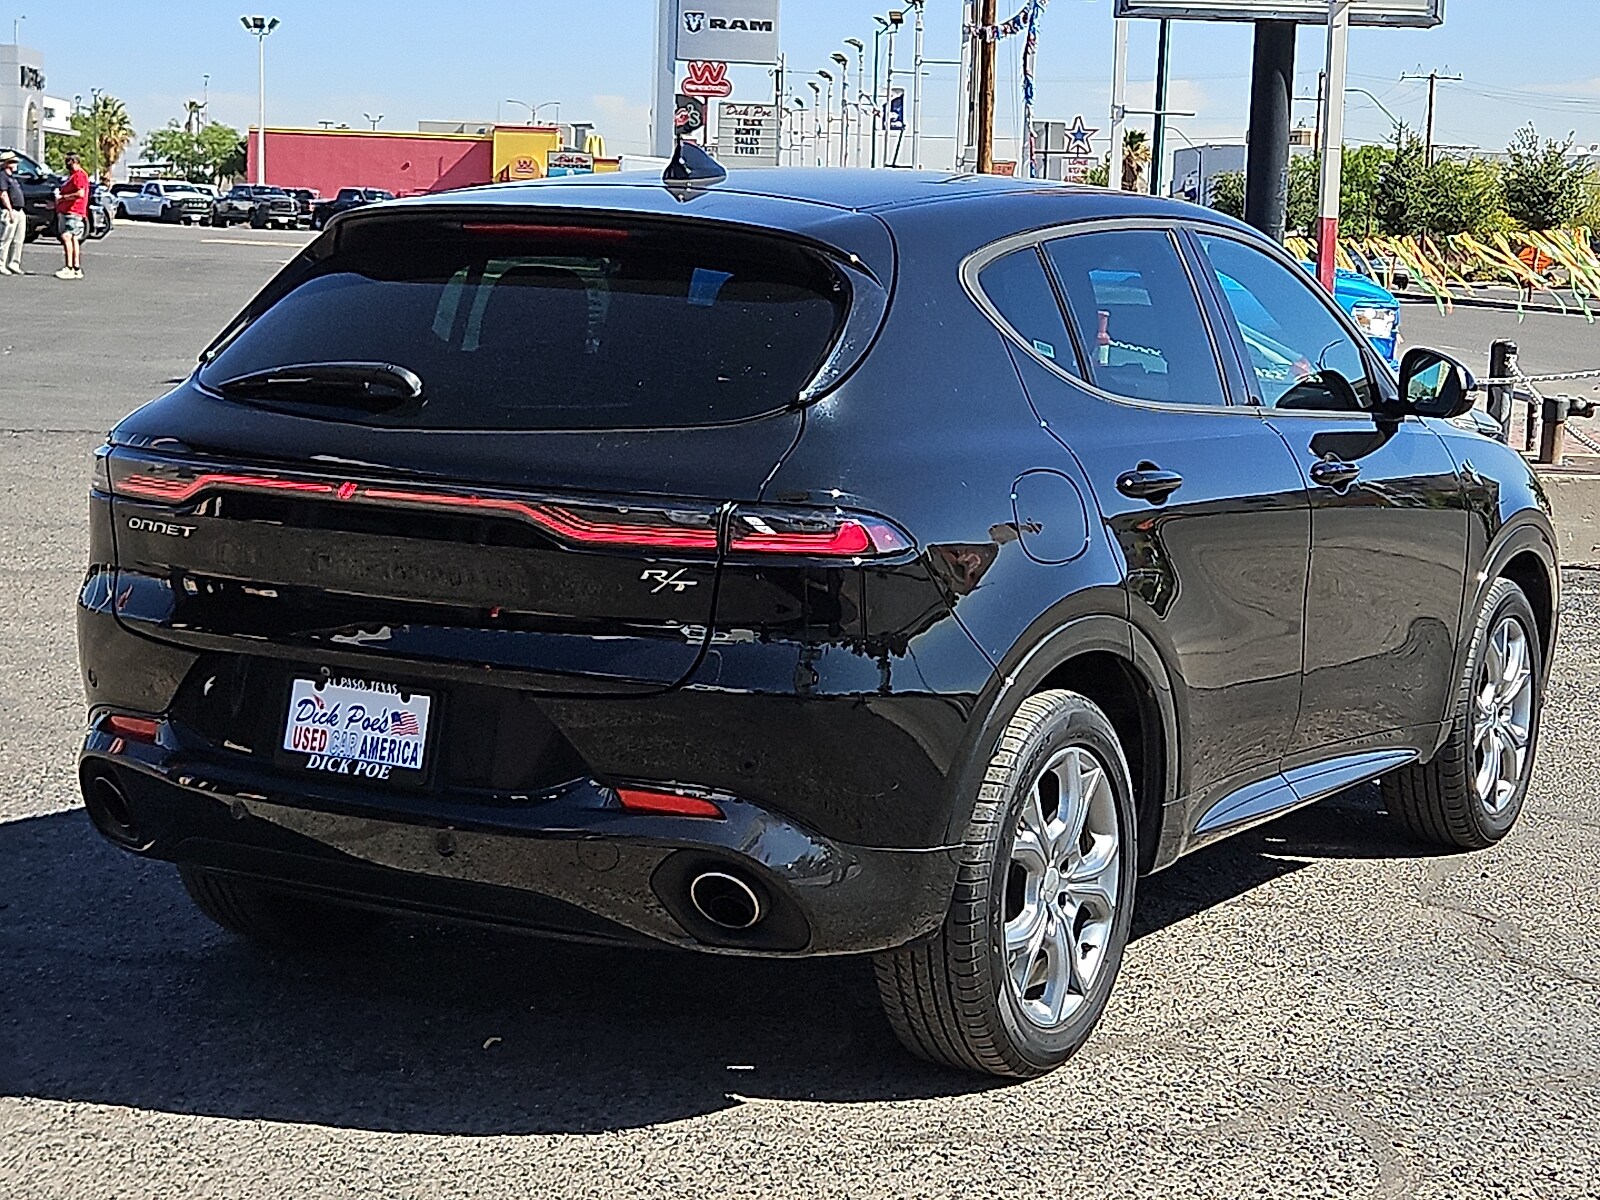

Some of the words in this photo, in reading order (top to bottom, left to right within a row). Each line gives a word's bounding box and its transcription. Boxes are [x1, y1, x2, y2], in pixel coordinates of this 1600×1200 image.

[709, 18, 773, 32] RAM
[753, 105, 772, 117] Poe
[734, 137, 760, 145] SALES
[734, 146, 760, 155] EVENT
[640, 567, 698, 593] R/T
[370, 680, 398, 696] TEXAS
[295, 698, 341, 727] Dick
[345, 704, 390, 734] Poe's
[292, 725, 328, 753] USED
[330, 729, 359, 759] CAR
[358, 734, 419, 767] AMERICA
[306, 754, 352, 775] DICK
[353, 760, 393, 781] POE
